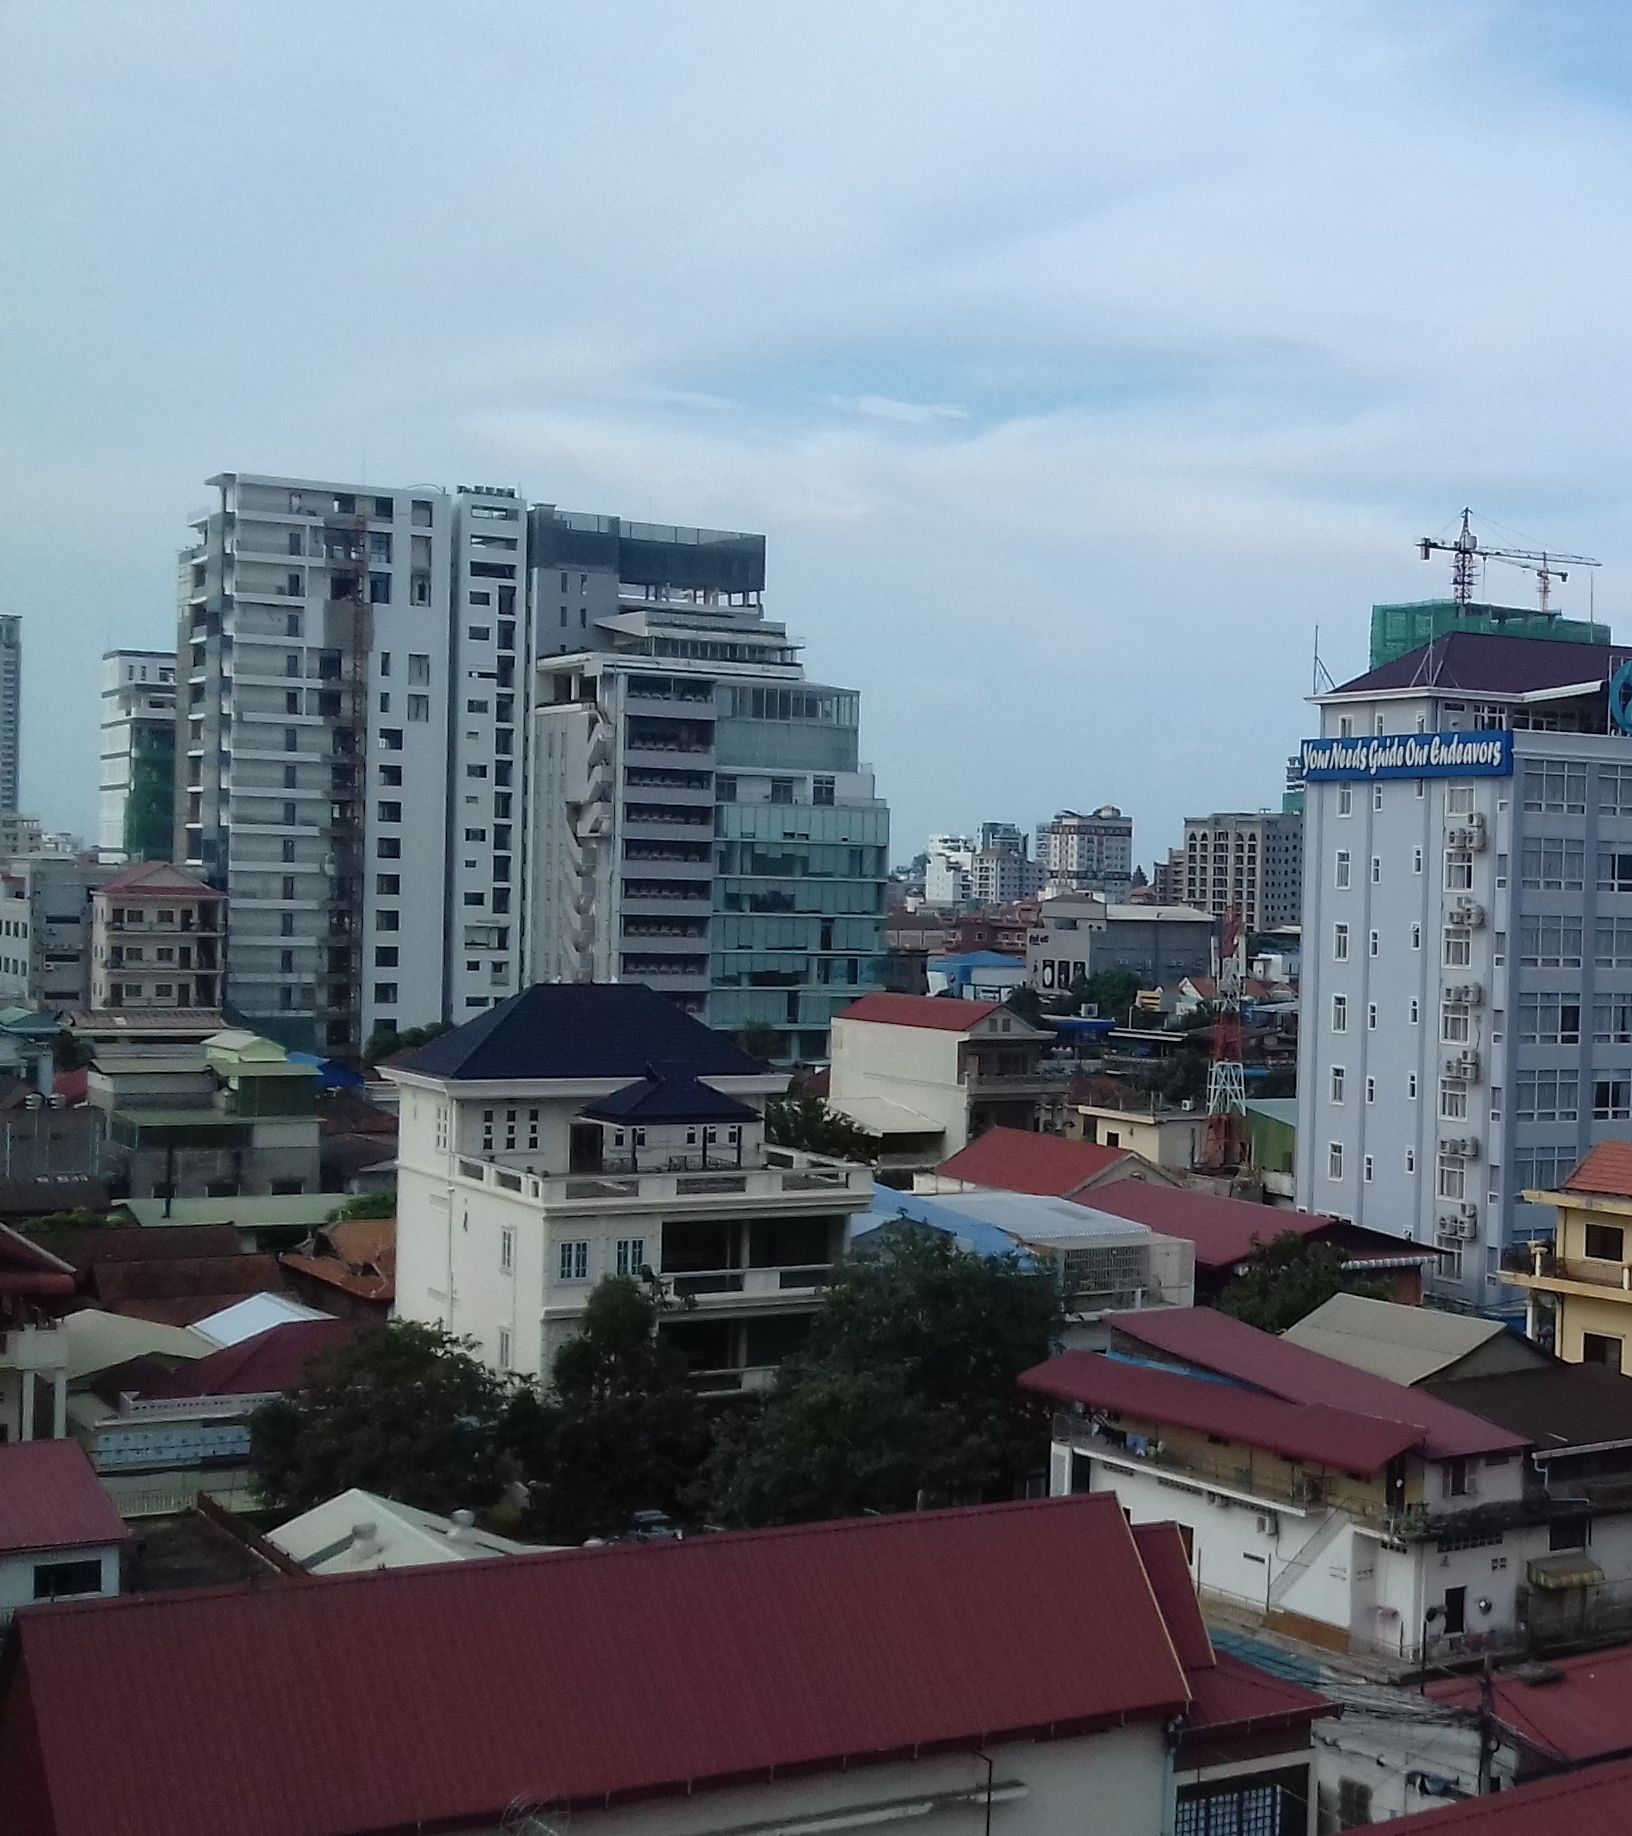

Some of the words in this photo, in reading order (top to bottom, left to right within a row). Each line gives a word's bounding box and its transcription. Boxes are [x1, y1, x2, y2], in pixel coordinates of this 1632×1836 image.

[1302, 742, 1330, 777] Your
[1328, 740, 1367, 771] Needs
[1368, 737, 1404, 776] Guide
[1405, 737, 1429, 767] Our
[1430, 733, 1501, 767] Endeavors
